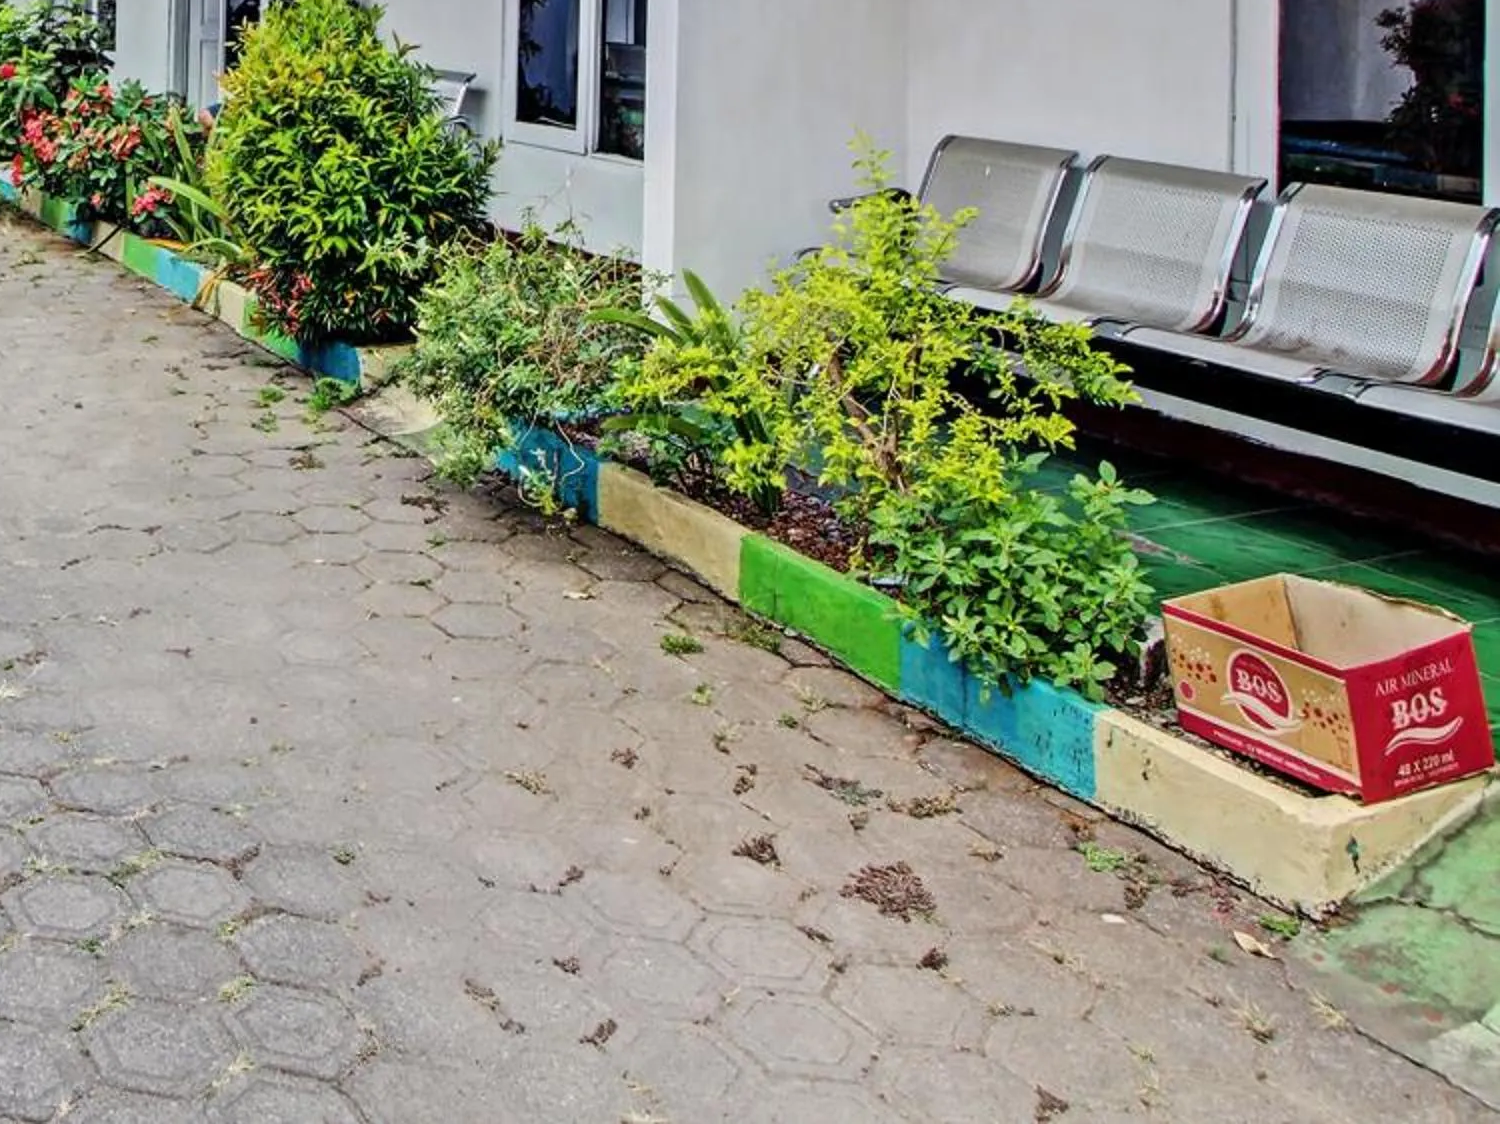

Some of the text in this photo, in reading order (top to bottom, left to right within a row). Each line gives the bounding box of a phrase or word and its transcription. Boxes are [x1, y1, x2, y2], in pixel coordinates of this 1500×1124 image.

[1235, 668, 1283, 703] BOS
[1375, 656, 1454, 697] AIR MINERAL
[1390, 686, 1448, 730] BOS
